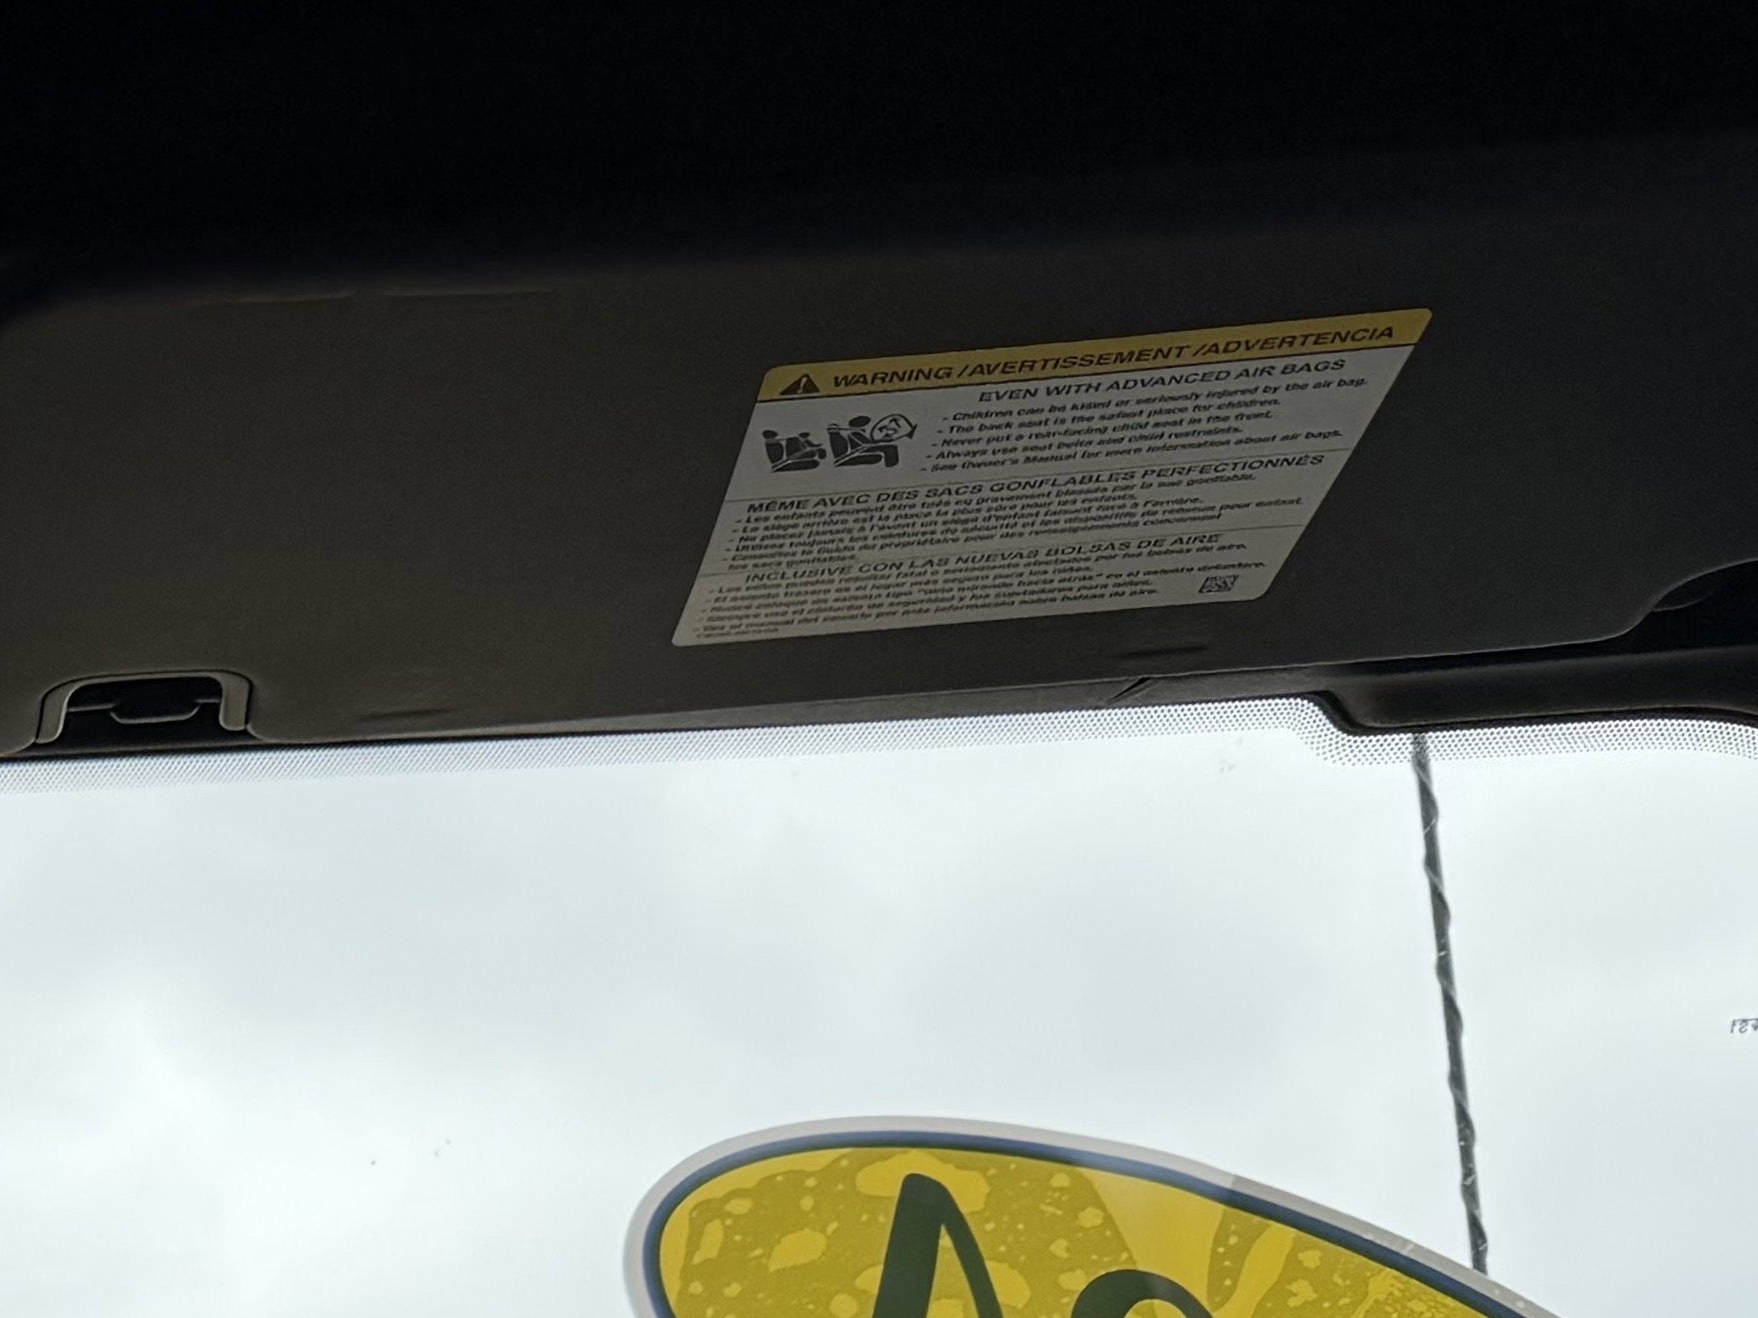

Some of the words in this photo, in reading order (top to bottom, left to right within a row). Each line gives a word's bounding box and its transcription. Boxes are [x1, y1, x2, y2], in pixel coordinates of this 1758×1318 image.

[830, 366, 955, 387] WARNING
[1192, 327, 1398, 355] /ADVERTENCIA
[976, 387, 1040, 402] EVEN
[1042, 382, 1103, 396] WITH
[1105, 370, 1232, 390] ADVANCED
[1234, 365, 1277, 378] AIR
[1278, 359, 1348, 374] BAGS
